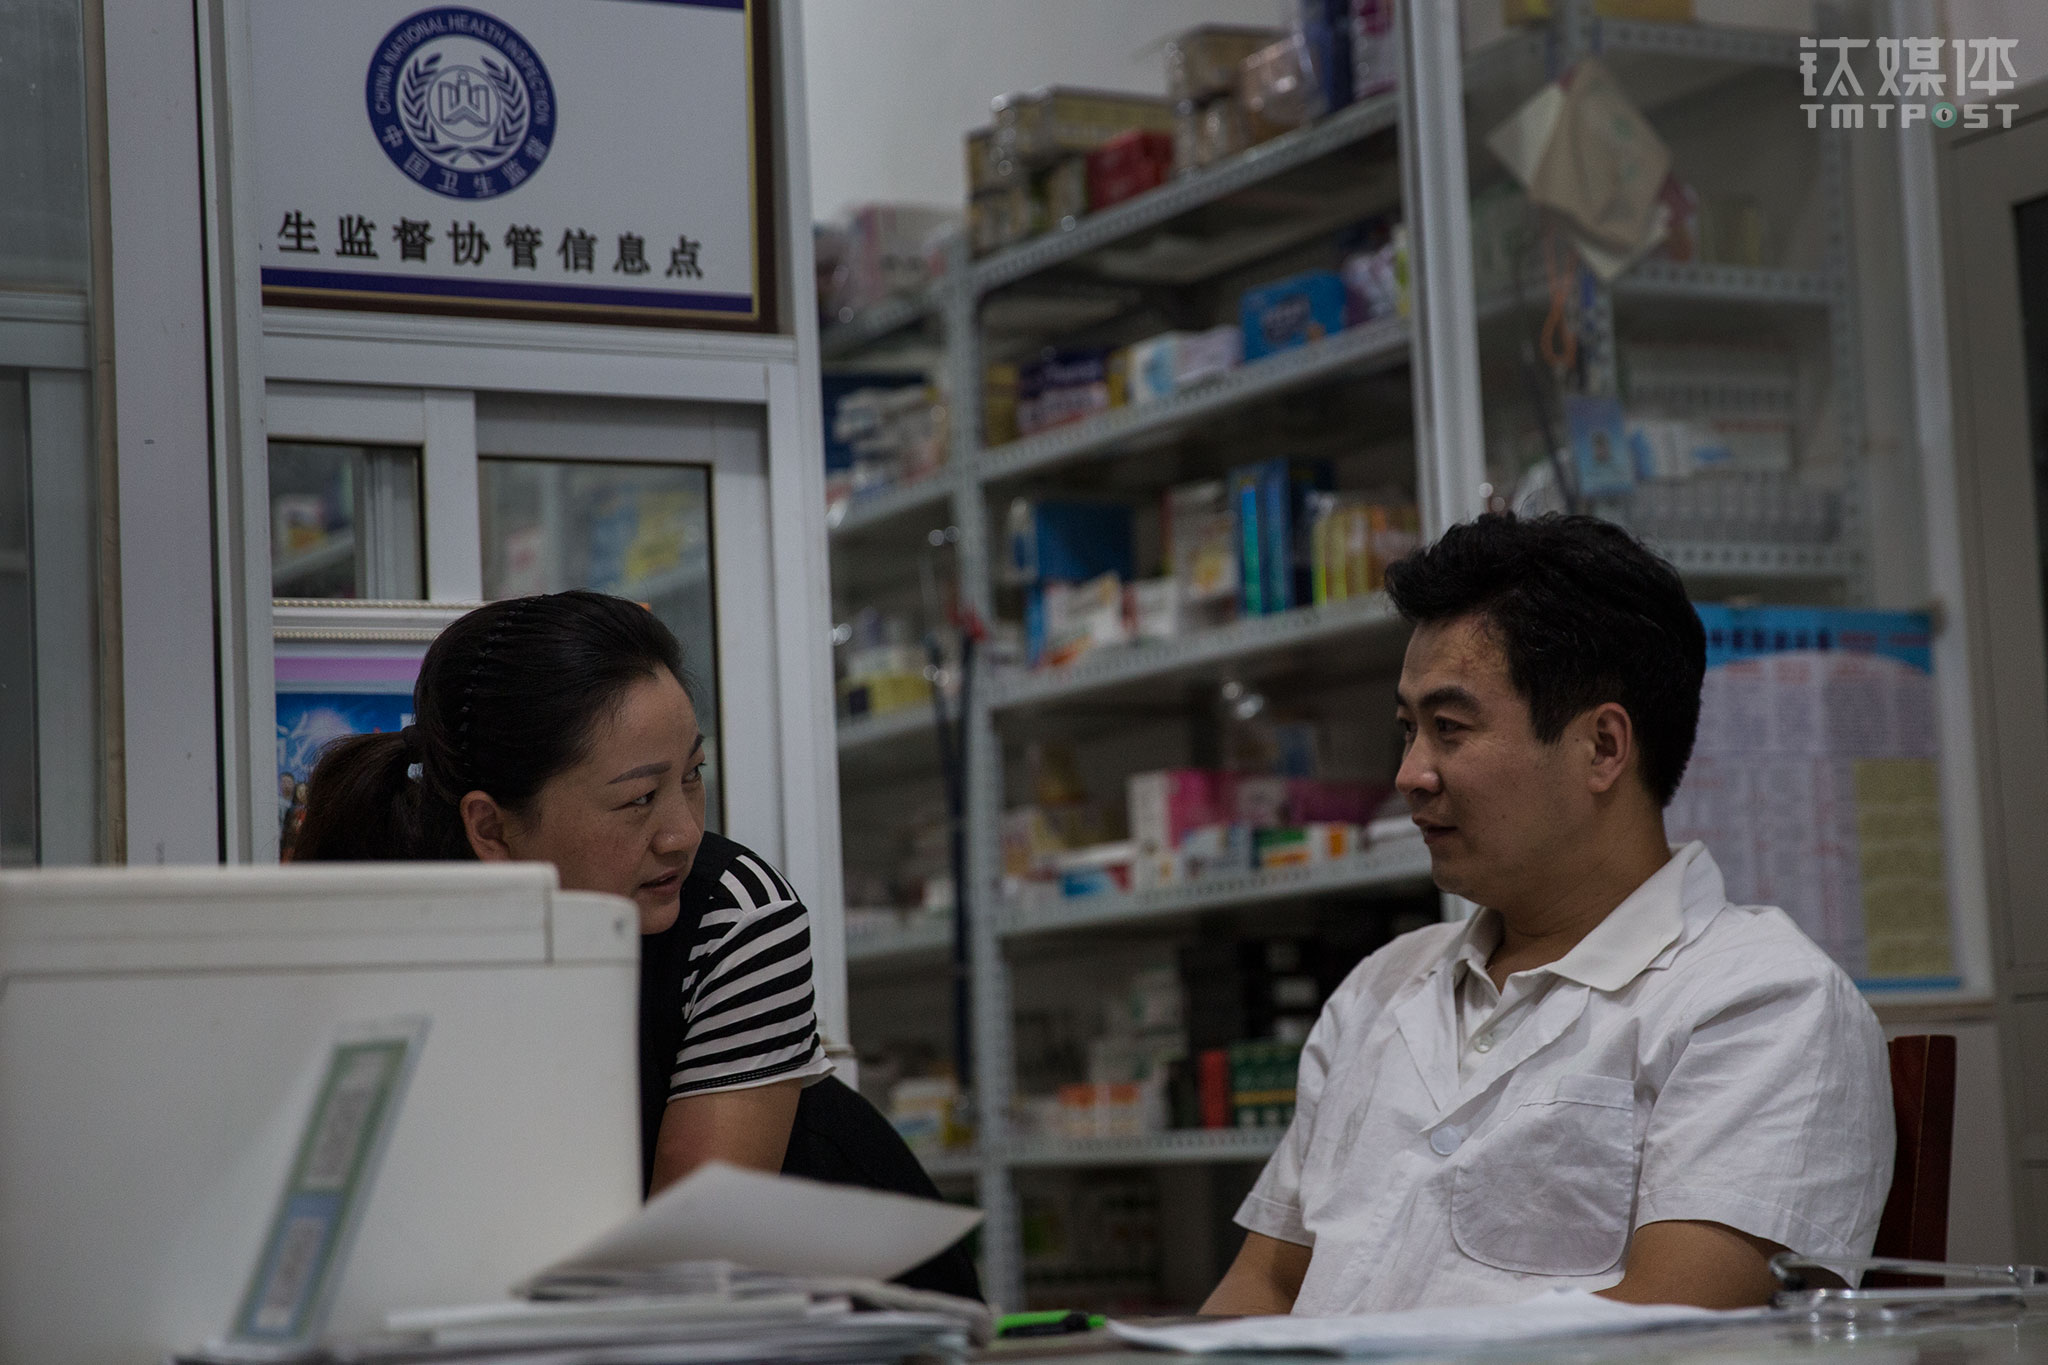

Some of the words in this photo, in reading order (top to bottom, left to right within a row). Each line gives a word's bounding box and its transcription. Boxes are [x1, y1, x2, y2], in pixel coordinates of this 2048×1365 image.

[383, 16, 448, 66] NATIONAL
[448, 13, 507, 45] HEALTH
[374, 64, 395, 115] CHINA
[502, 36, 551, 126] INSPECTION
[259, 208, 704, 278] 生监督协管信息点
